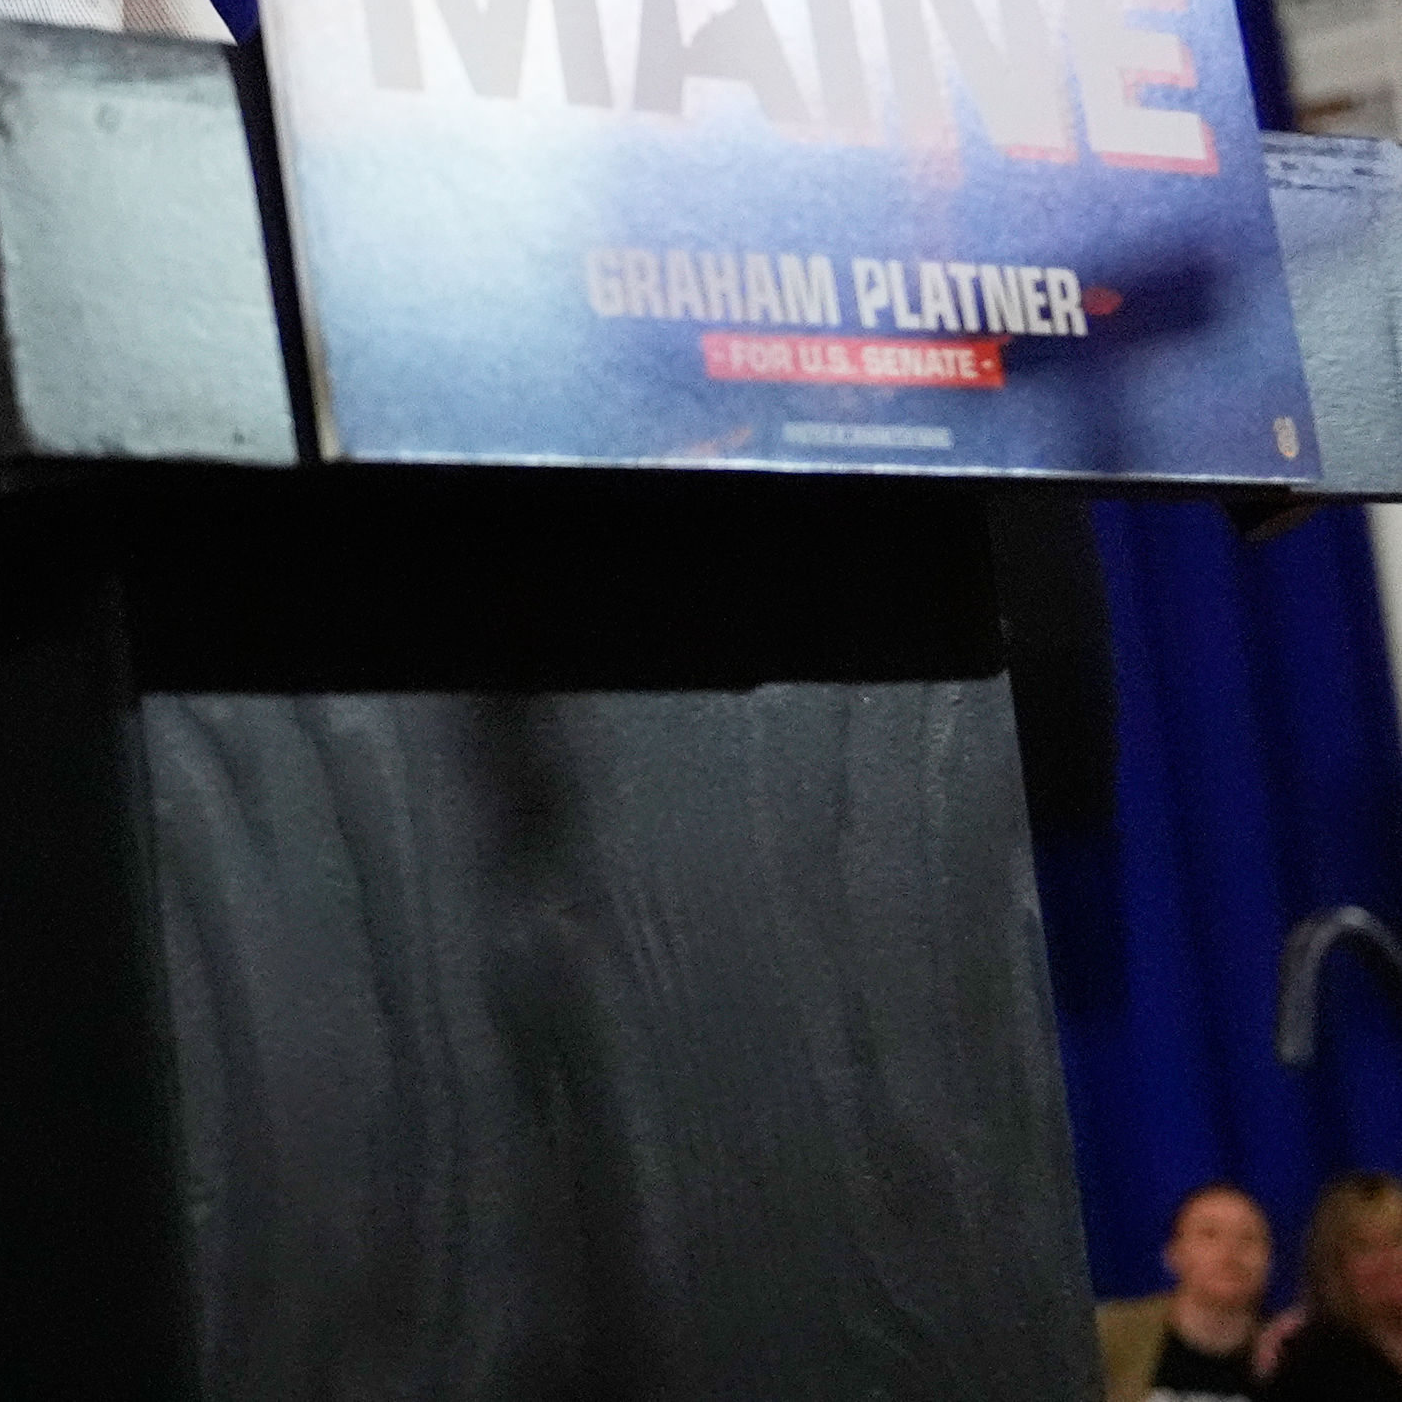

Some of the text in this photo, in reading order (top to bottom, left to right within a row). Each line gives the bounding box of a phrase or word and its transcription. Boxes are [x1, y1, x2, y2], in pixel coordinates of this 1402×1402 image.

[586, 246, 1089, 337] GRAHAM PLATNER
[729, 340, 793, 374] FOR
[861, 345, 980, 379] SENATE
